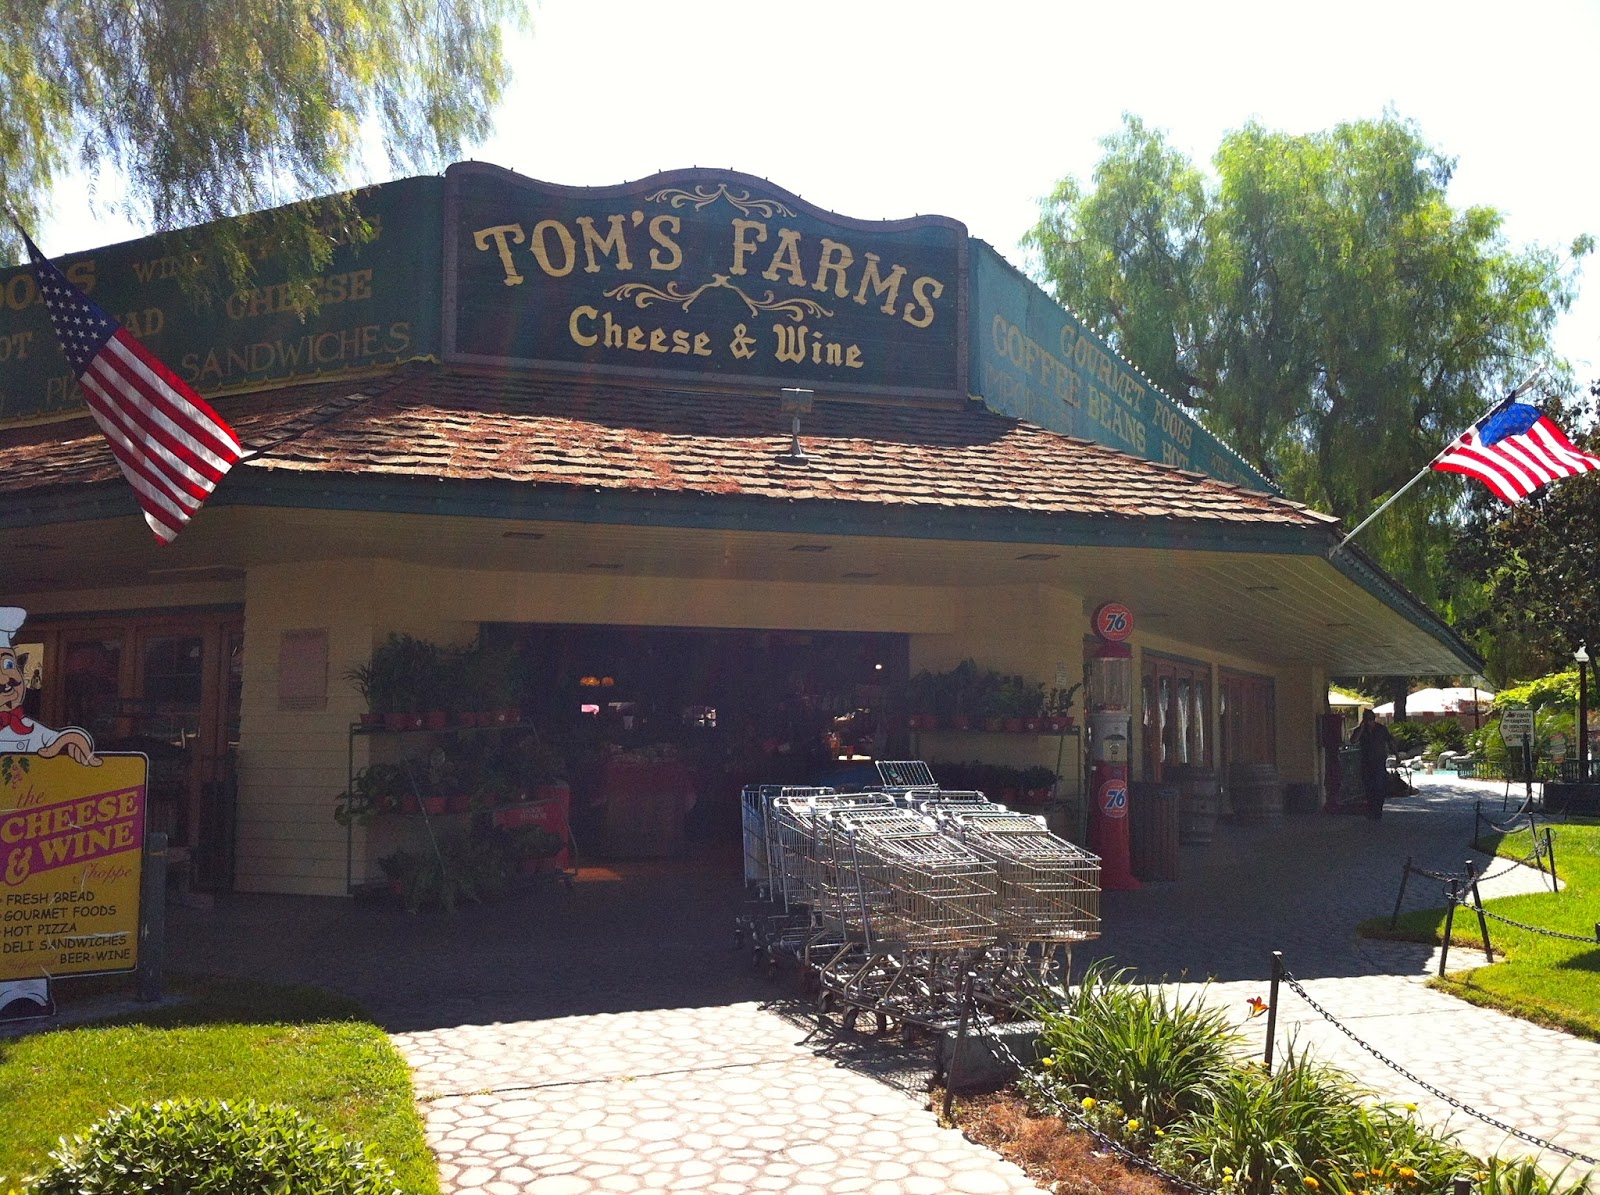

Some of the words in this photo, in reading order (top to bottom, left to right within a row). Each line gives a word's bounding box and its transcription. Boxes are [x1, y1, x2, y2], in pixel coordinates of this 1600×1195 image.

[473, 209, 684, 287] TOM'S
[730, 218, 944, 328] FARMS
[181, 322, 411, 384] SANDWICHES
[569, 305, 712, 357] Cheese
[732, 323, 757, 360] &
[773, 323, 864, 369] Wine
[992, 313, 1081, 409] COFFEE
[1087, 383, 1147, 454] BEANS
[1060, 324, 1146, 413] GOURMET
[1152, 399, 1193, 450] FOODS
[1103, 612, 1128, 633] 76
[16, 785, 46, 808] the
[1103, 787, 1127, 809] 76
[0, 791, 139, 844] CHEESE
[4, 846, 33, 887] &
[38, 820, 135, 865] WINE
[4, 907, 68, 922] GOURMET
[73, 905, 117, 918] FOODS
[6, 893, 49, 906] FRESH
[54, 891, 95, 903] BREAD
[2, 941, 34, 954] DELI
[39, 935, 127, 951] SANDWICHES
[3, 925, 33, 938] HOT
[37, 923, 77, 935] PIZZA
